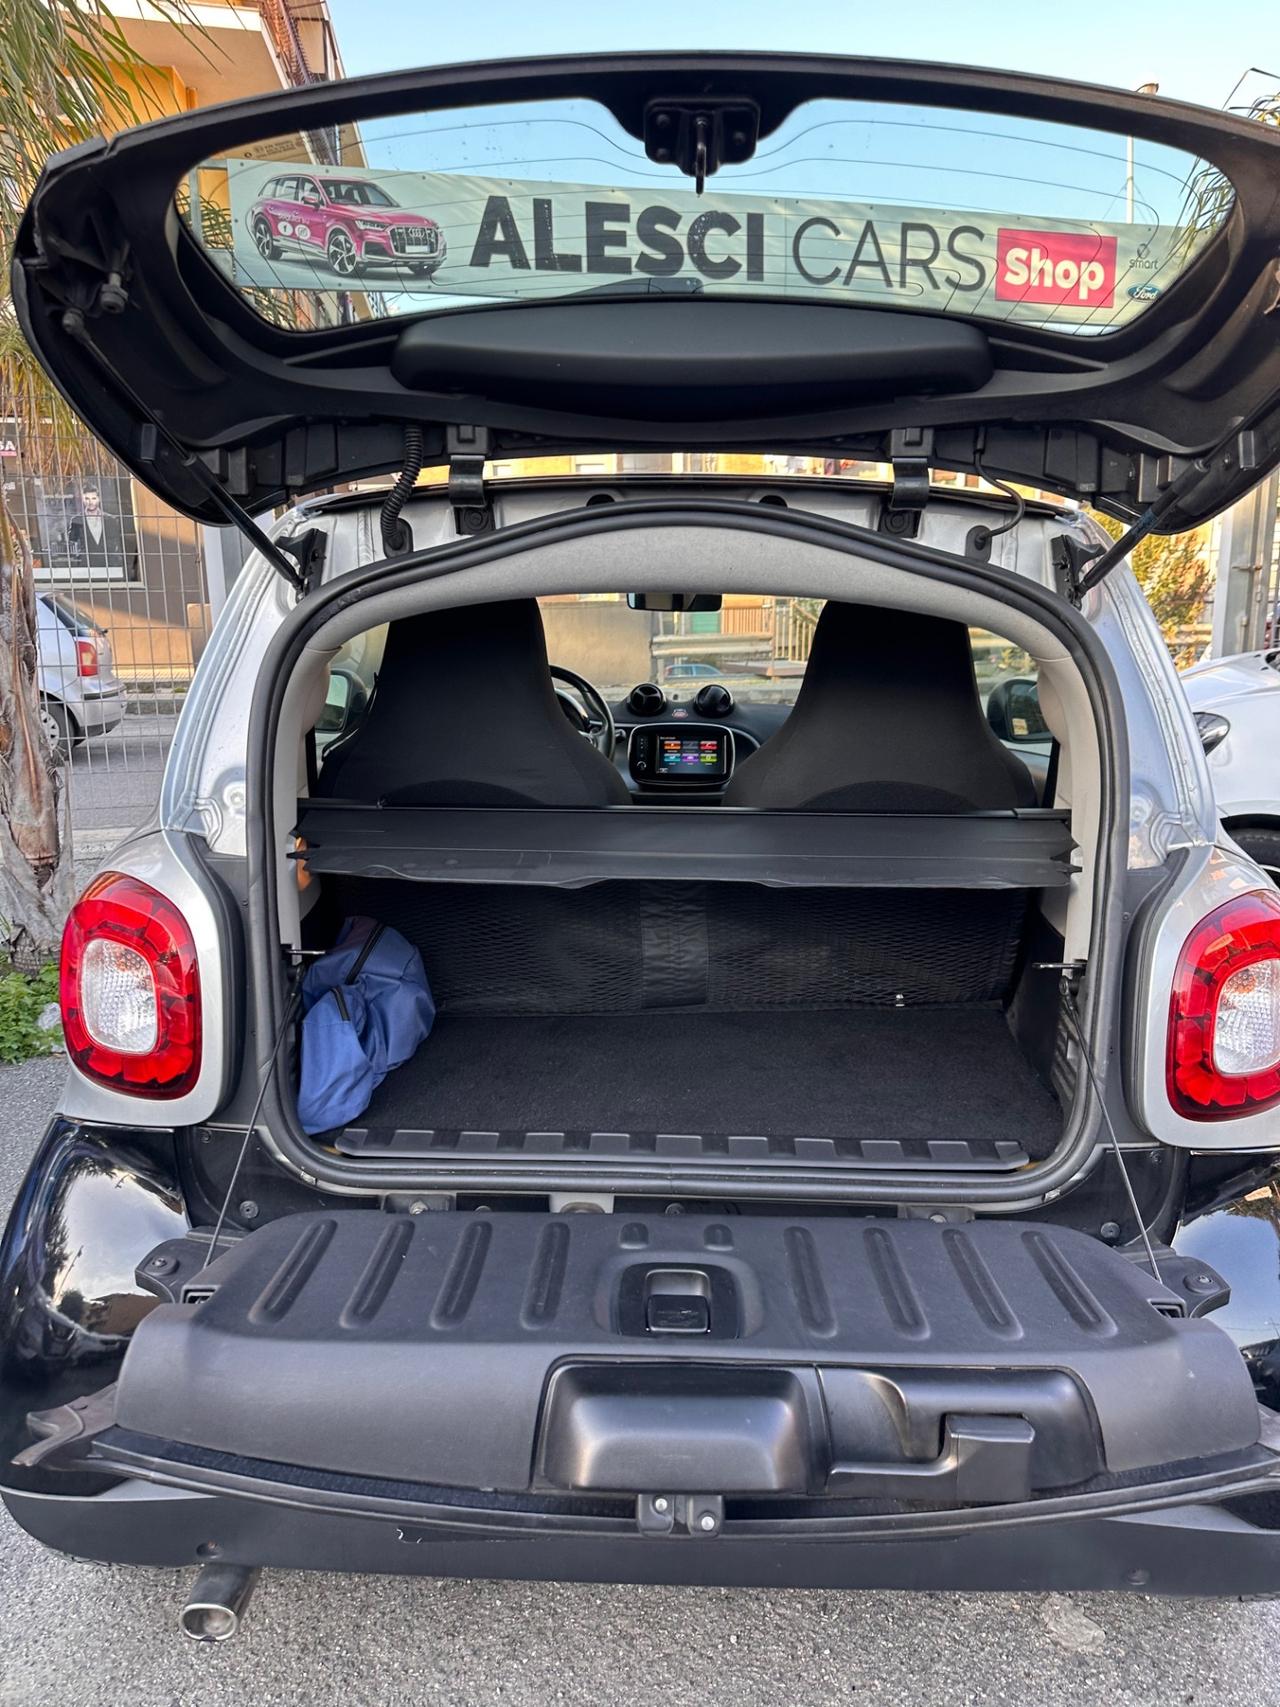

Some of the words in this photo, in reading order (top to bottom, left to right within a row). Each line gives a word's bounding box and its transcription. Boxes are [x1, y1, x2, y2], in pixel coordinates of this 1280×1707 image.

[469, 195, 765, 282] ALESCI
[792, 216, 987, 292] CARS
[1003, 247, 1105, 300] Shop
[1129, 259, 1159, 270] smart
[1131, 284, 1159, 300] Ford
